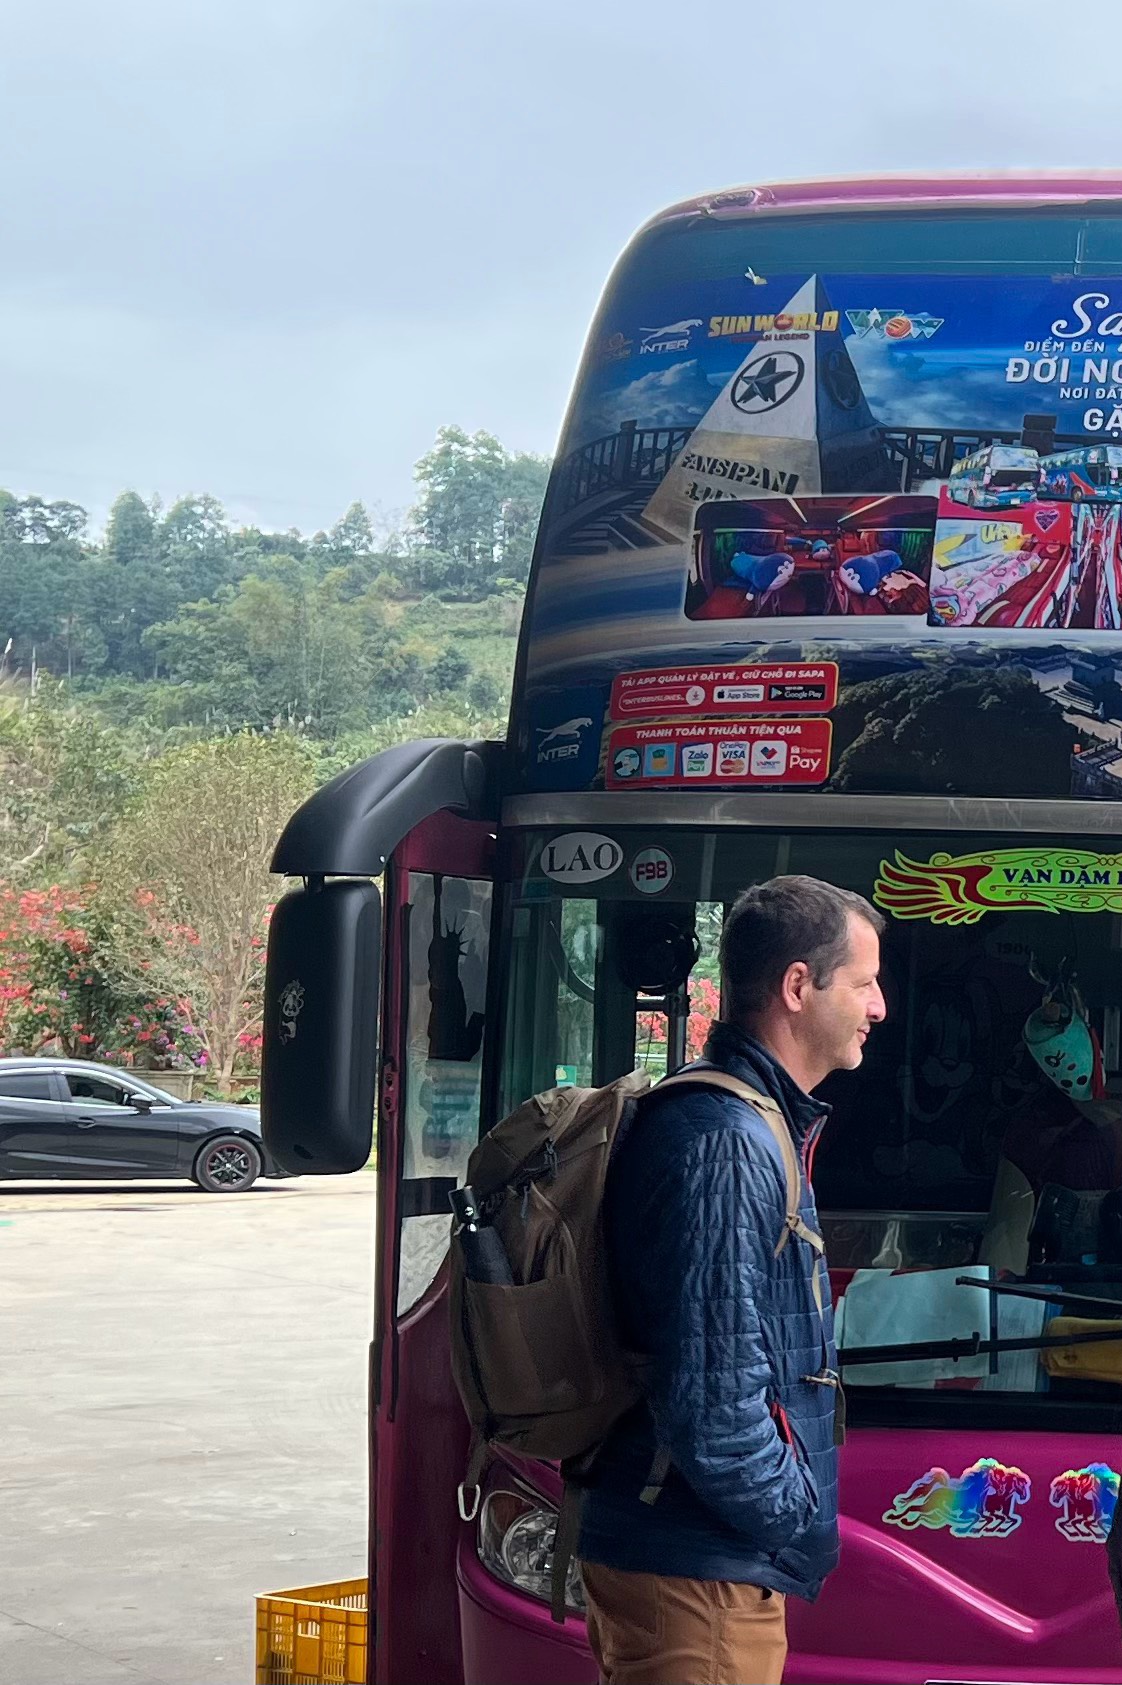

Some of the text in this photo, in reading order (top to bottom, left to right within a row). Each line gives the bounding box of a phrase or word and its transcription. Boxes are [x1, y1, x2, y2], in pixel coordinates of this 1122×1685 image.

[707, 310, 839, 338] SUN WORLD
[639, 339, 690, 355] INTER
[1023, 336, 1106, 353] ĐIỂM ĐẾN
[1005, 352, 1070, 384] ĐỜI
[1059, 386, 1089, 400] NƠI
[637, 677, 657, 686] APP
[798, 669, 825, 679] SAPA
[727, 691, 761, 700] App Store
[784, 690, 823, 700] Google Play
[636, 723, 802, 739] THANH TOÁN THUẬN TIỆN QUA
[537, 744, 580, 764] INTER
[688, 750, 709, 760] Zalo
[721, 750, 746, 759] VISA
[789, 755, 822, 772] Pay
[547, 842, 619, 873] LAO
[635, 860, 668, 882] F98
[1002, 867, 1053, 888] VẠN
[1058, 865, 1111, 889] DẶM
